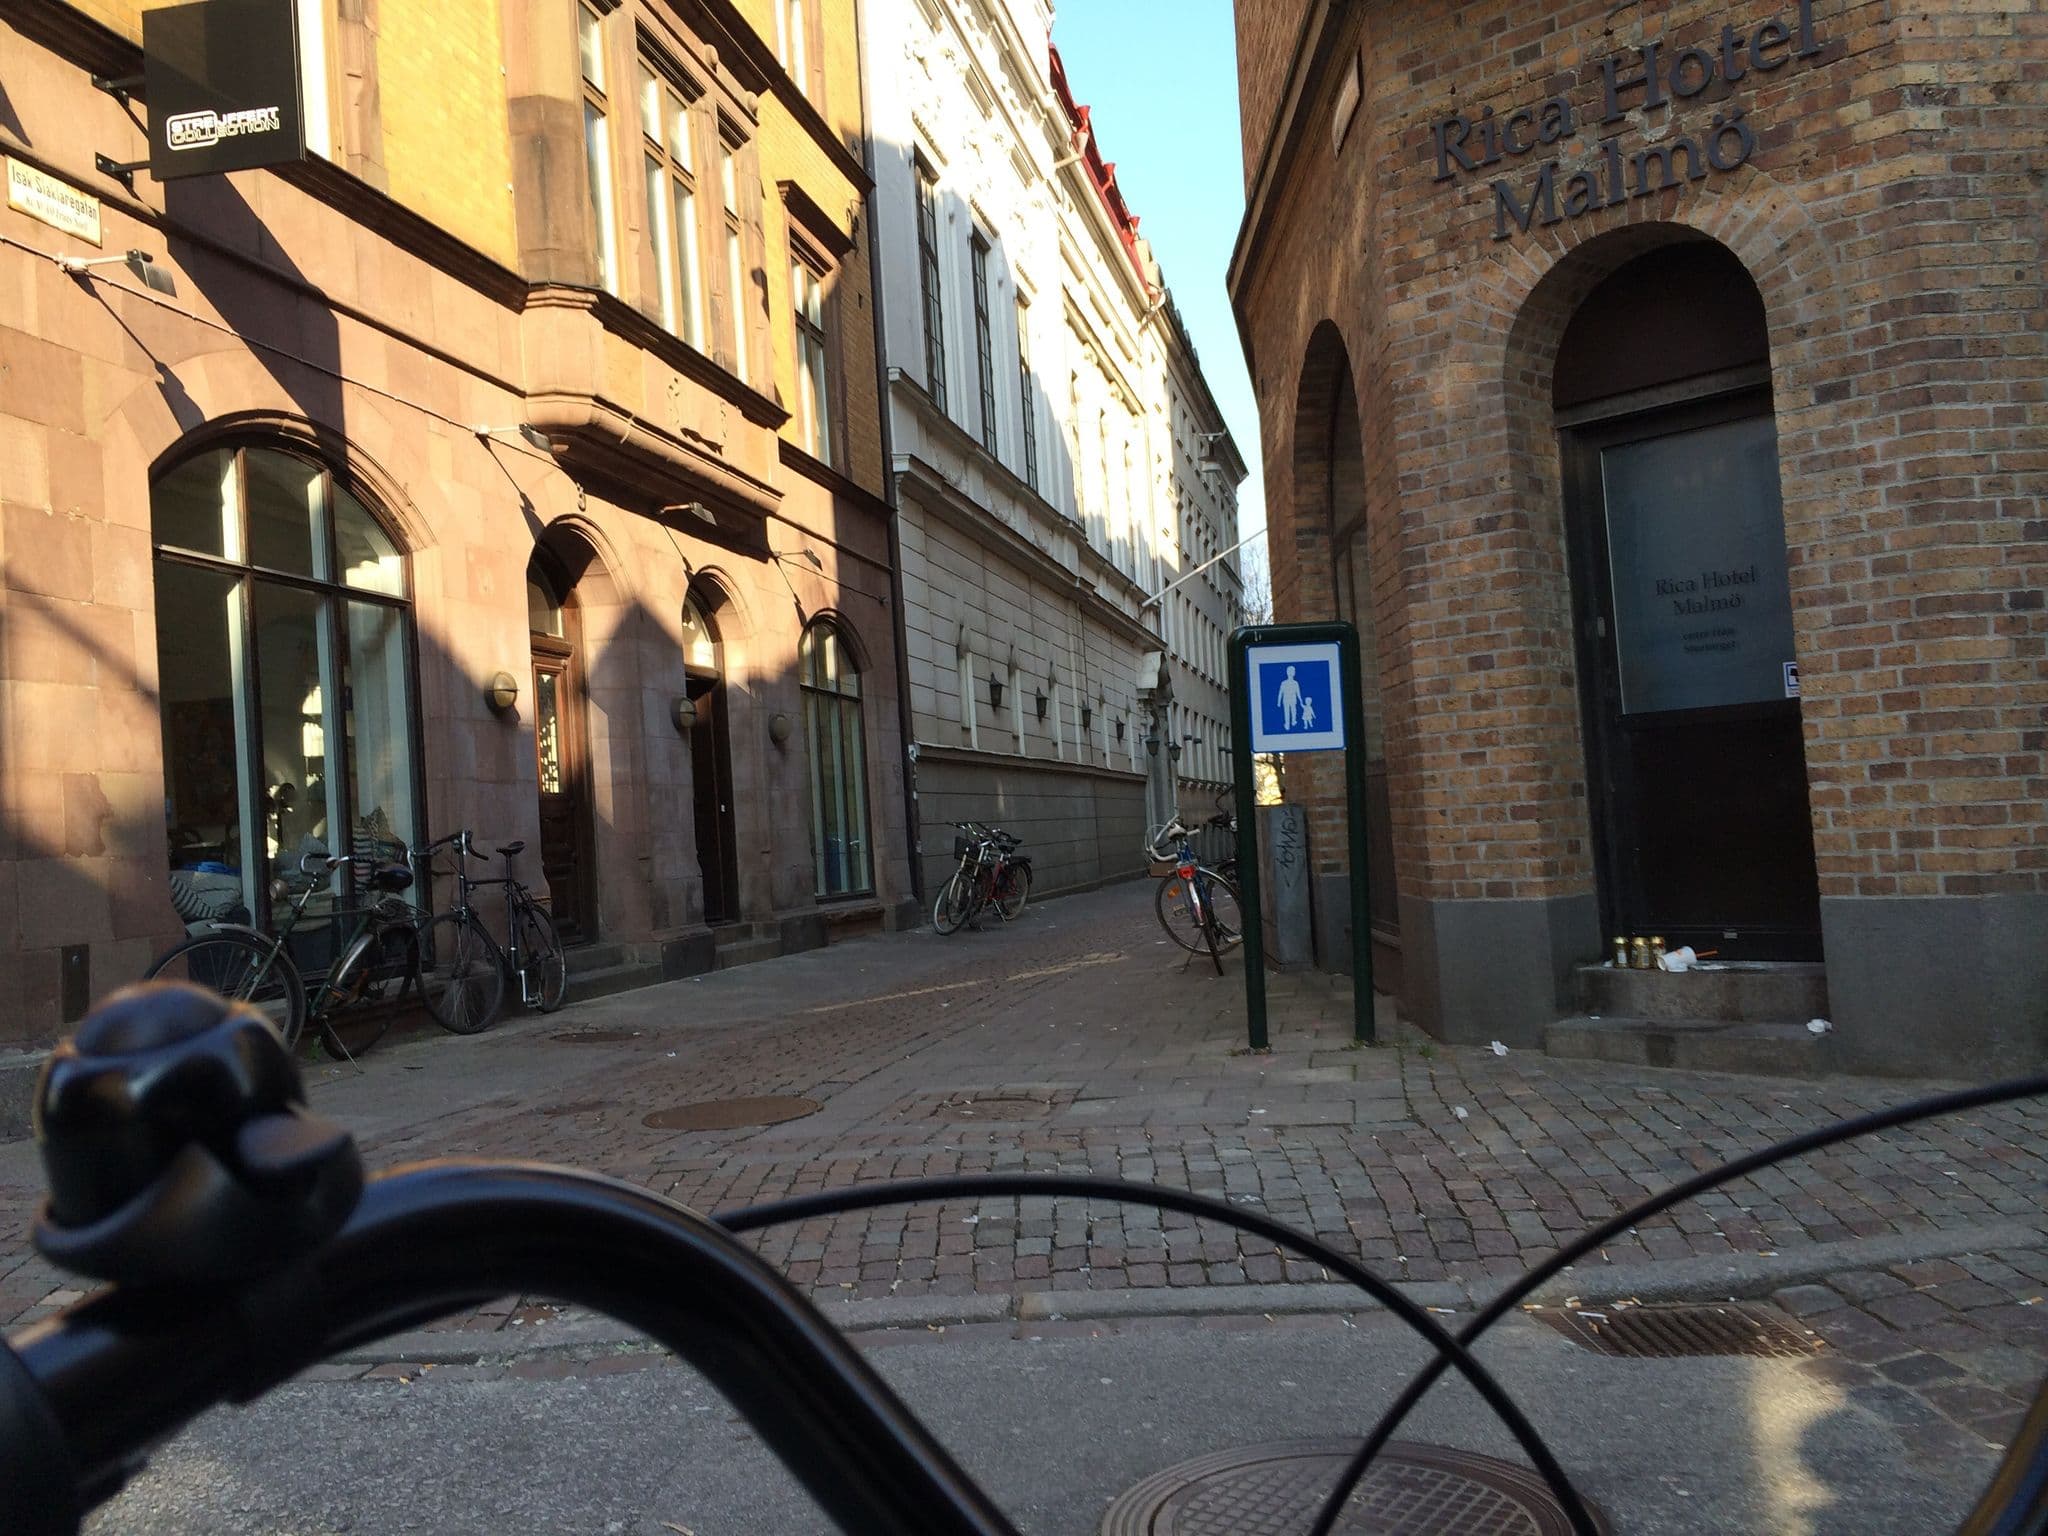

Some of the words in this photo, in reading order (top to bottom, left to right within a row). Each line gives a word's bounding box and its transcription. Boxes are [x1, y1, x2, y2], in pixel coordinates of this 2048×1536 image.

[1431, 97, 1576, 183] Rica
[1601, 0, 1823, 125] Hotel
[172, 118, 280, 145] COLLECTION
[1491, 106, 1756, 241] Malmö
[1656, 577, 1697, 596] Rica
[1702, 565, 1757, 590] Hotel
[1673, 593, 1743, 616] Malmö
